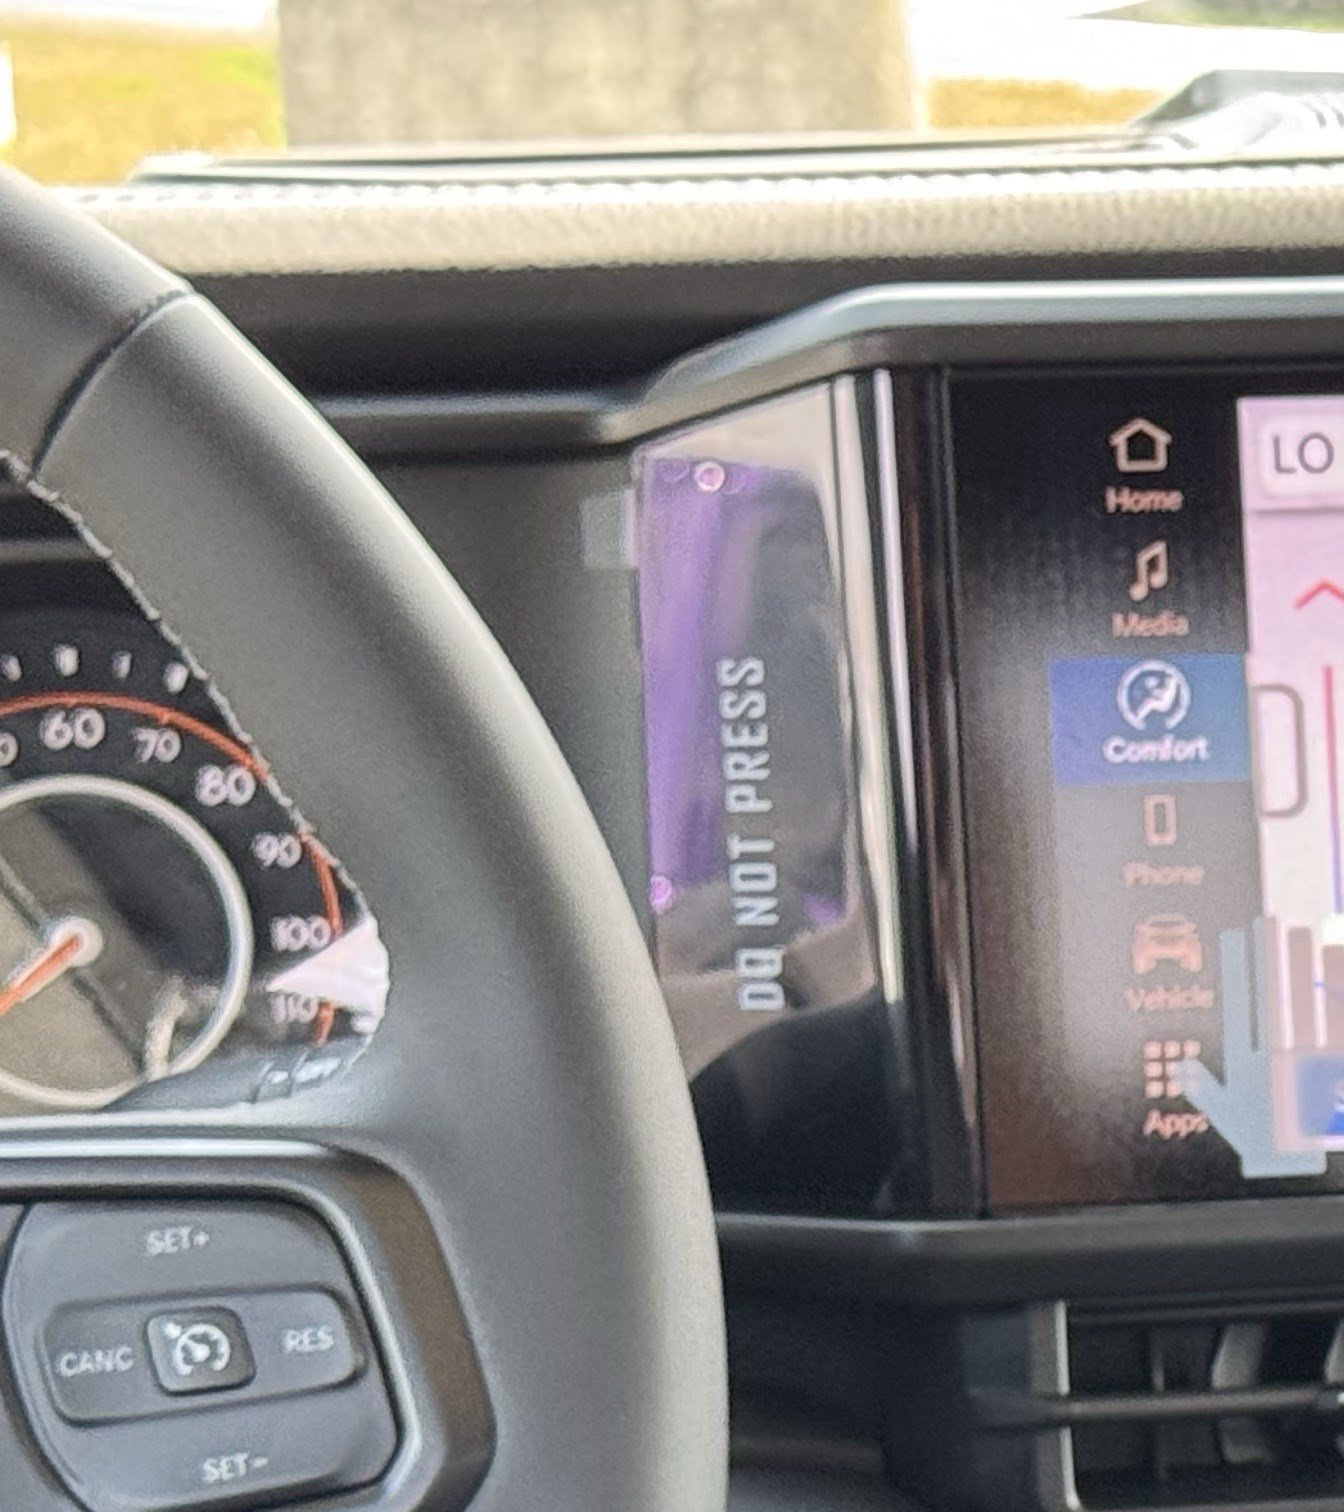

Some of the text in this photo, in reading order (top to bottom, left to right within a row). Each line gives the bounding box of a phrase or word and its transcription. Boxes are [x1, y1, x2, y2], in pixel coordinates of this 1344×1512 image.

[1273, 433, 1335, 475] LO
[1106, 486, 1183, 513] Home
[1112, 612, 1189, 637] Media
[40, 707, 106, 751] 60
[131, 725, 182, 764] 70
[1103, 735, 1209, 763] Comfort
[195, 764, 256, 806] 80
[717, 656, 786, 1012] DO NOT PRESS
[251, 832, 302, 870] 90
[1123, 860, 1204, 886] Phone
[271, 914, 332, 951] 100
[1126, 986, 1214, 1012] Vehicle
[1143, 1109, 1208, 1140] Apps
[280, 1327, 334, 1353] RES
[57, 1346, 135, 1377] CANC
